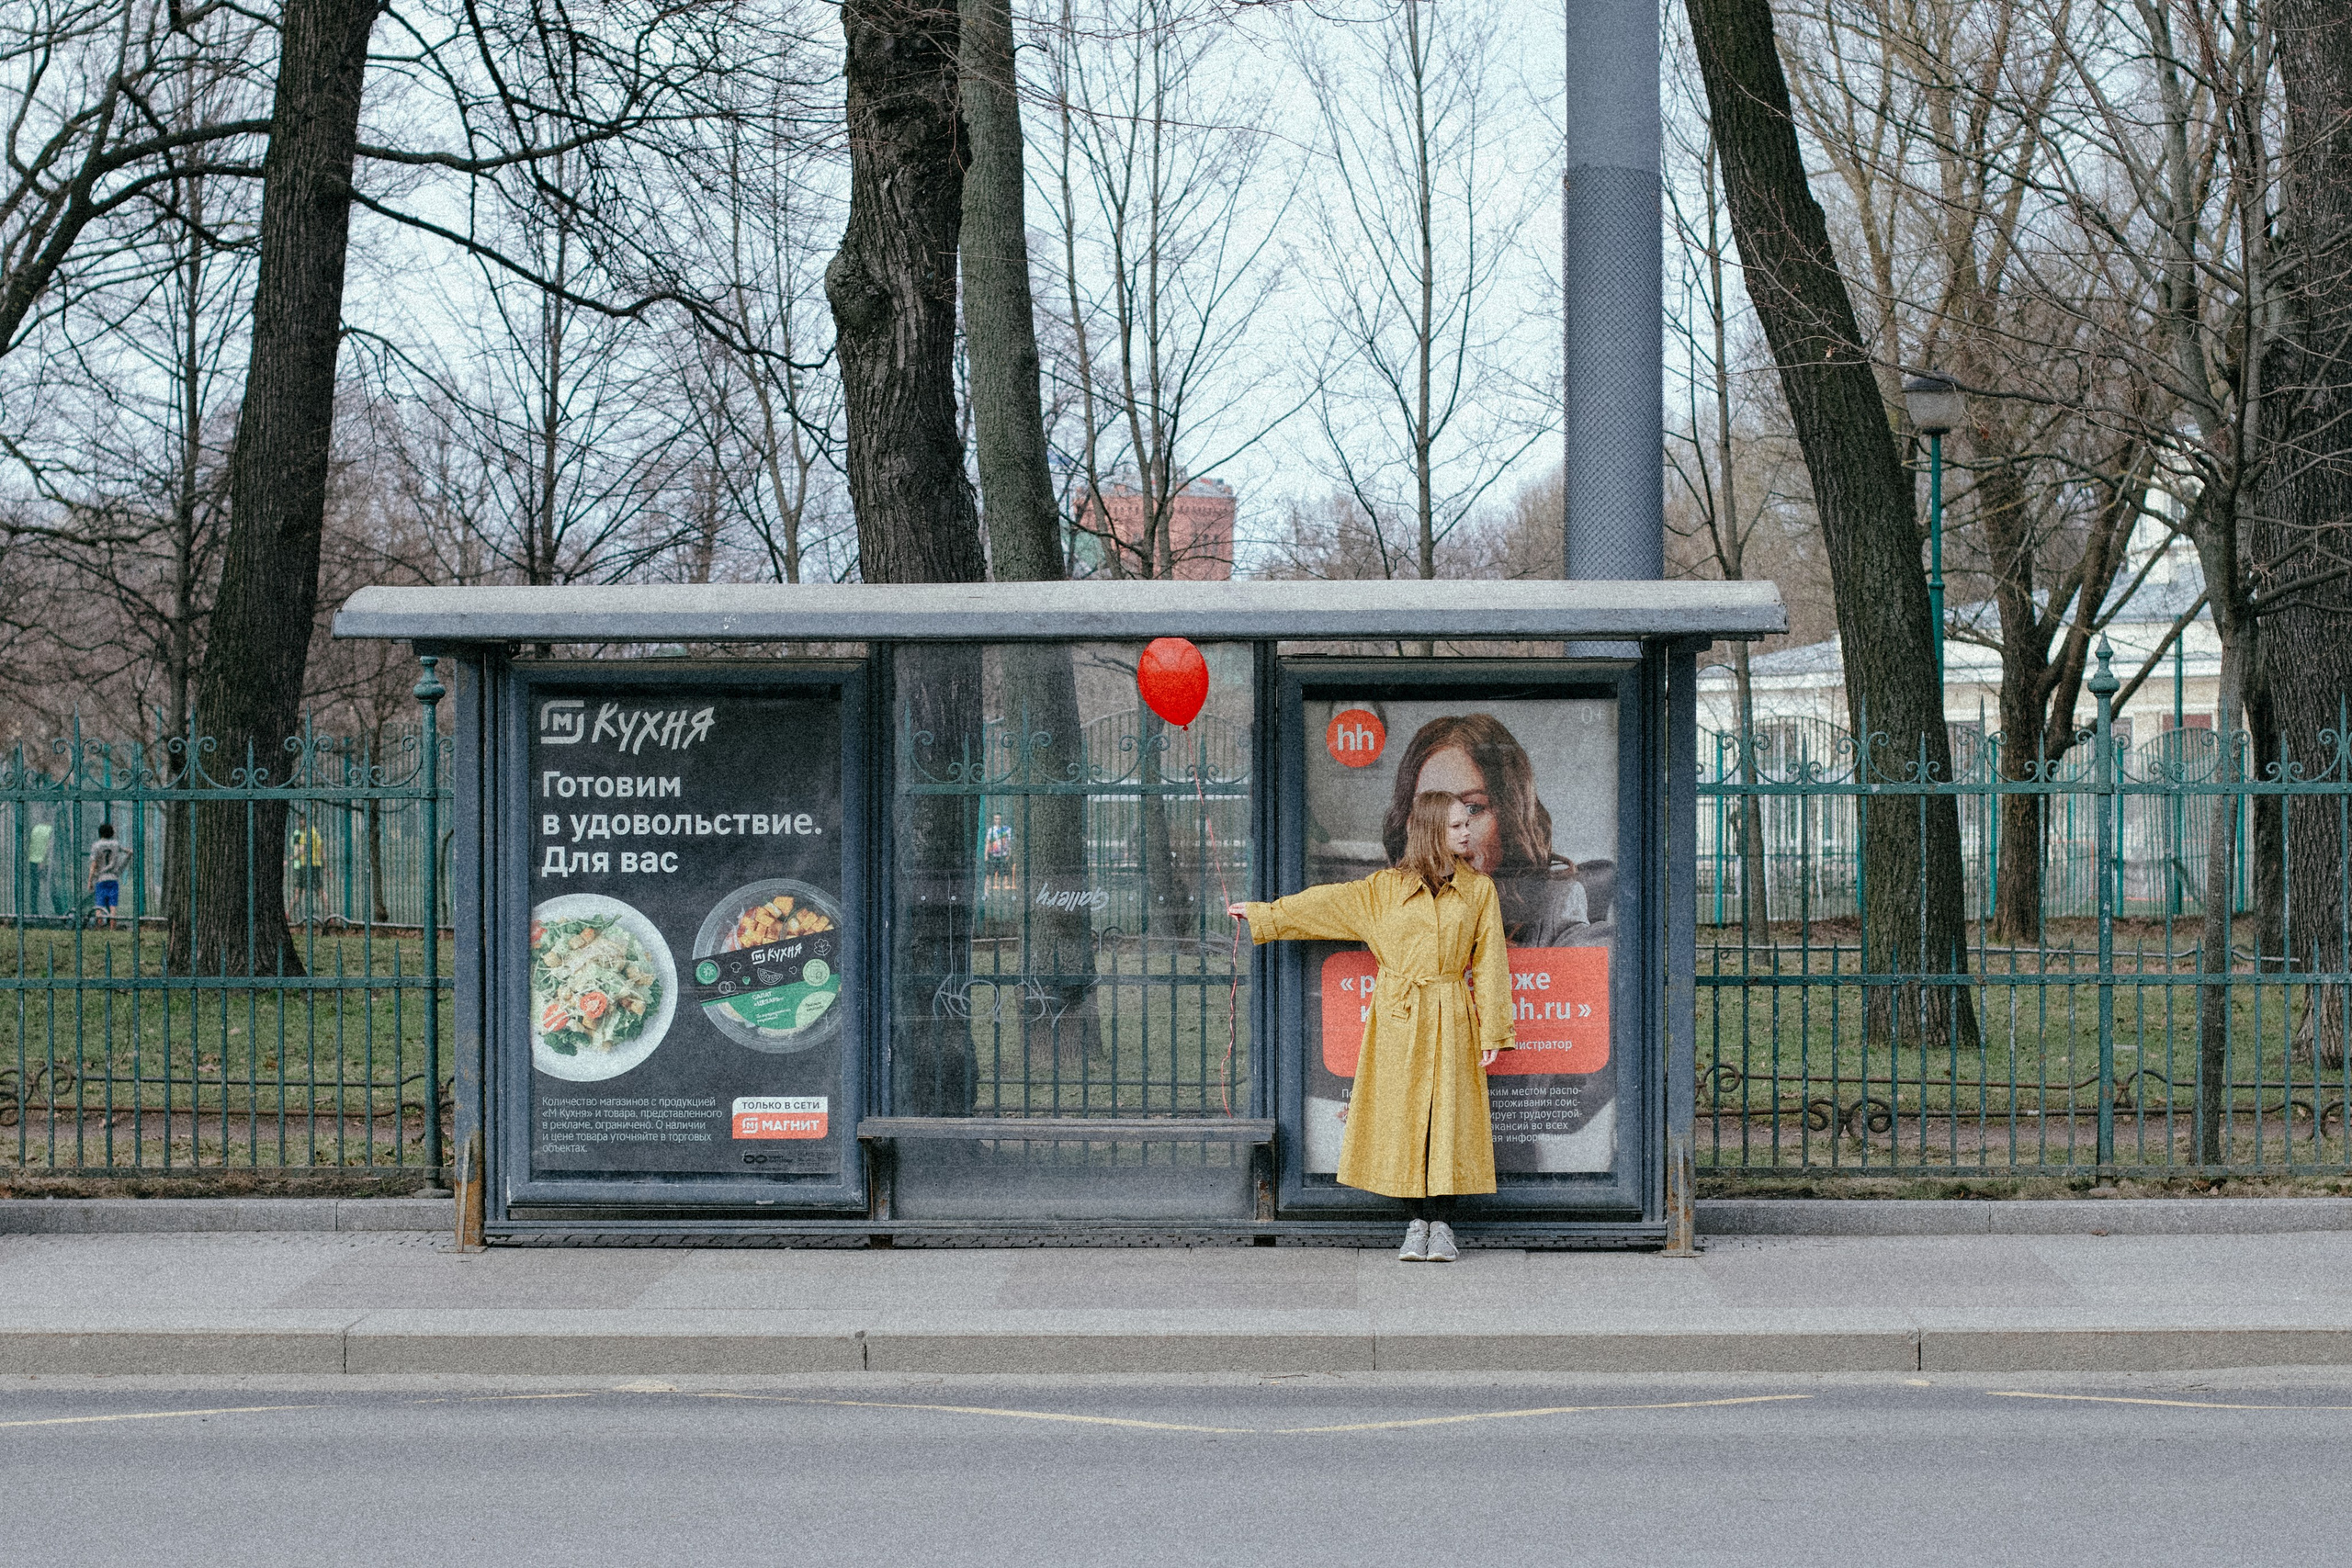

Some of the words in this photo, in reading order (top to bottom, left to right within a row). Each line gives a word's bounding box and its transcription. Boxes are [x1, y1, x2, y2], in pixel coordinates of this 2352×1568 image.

[1337, 723, 1374, 751] hh
[543, 771, 681, 797] Готовим
[542, 814, 560, 835] в
[570, 812, 822, 842] удовольствие.
[541, 846, 609, 877] Для
[620, 851, 679, 873] вас
[1035, 881, 1110, 912] Gallery
[1511, 1087, 1547, 1096] местом
[1550, 1087, 1582, 1097] распо-
[542, 1096, 597, 1107] Количество
[599, 1098, 649, 1107] магазинов
[650, 1098, 657, 1106] с
[659, 1096, 716, 1109] продукцией
[742, 1101, 781, 1110] ТОЛЬКО
[785, 1101, 790, 1110] В
[794, 1101, 820, 1110] СЕТИ
[1492, 1099, 1552, 1109] проживания
[1555, 1098, 1580, 1107] соис-
[542, 1108, 557, 1118] «М
[560, 1108, 593, 1120] Кухня»
[594, 1110, 602, 1118] и
[604, 1110, 638, 1120] товара,
[640, 1110, 723, 1120] представленного
[1520, 1109, 1582, 1120] трудоустрой-
[542, 1121, 548, 1130] в
[550, 1121, 593, 1131] рекламе,
[594, 1121, 653, 1132] ограничено.
[655, 1119, 663, 1130] О
[665, 1121, 706, 1130] наличии
[762, 1120, 820, 1131] МАГНИТ
[1532, 1122, 1543, 1130] во
[1545, 1121, 1568, 1130] всех
[542, 1133, 548, 1141] и
[551, 1133, 574, 1142] цене
[576, 1133, 608, 1144] товара
[610, 1131, 659, 1144] уточняйте
[661, 1133, 666, 1141] в
[669, 1133, 712, 1144] торговых
[542, 1142, 588, 1153] объектах.
